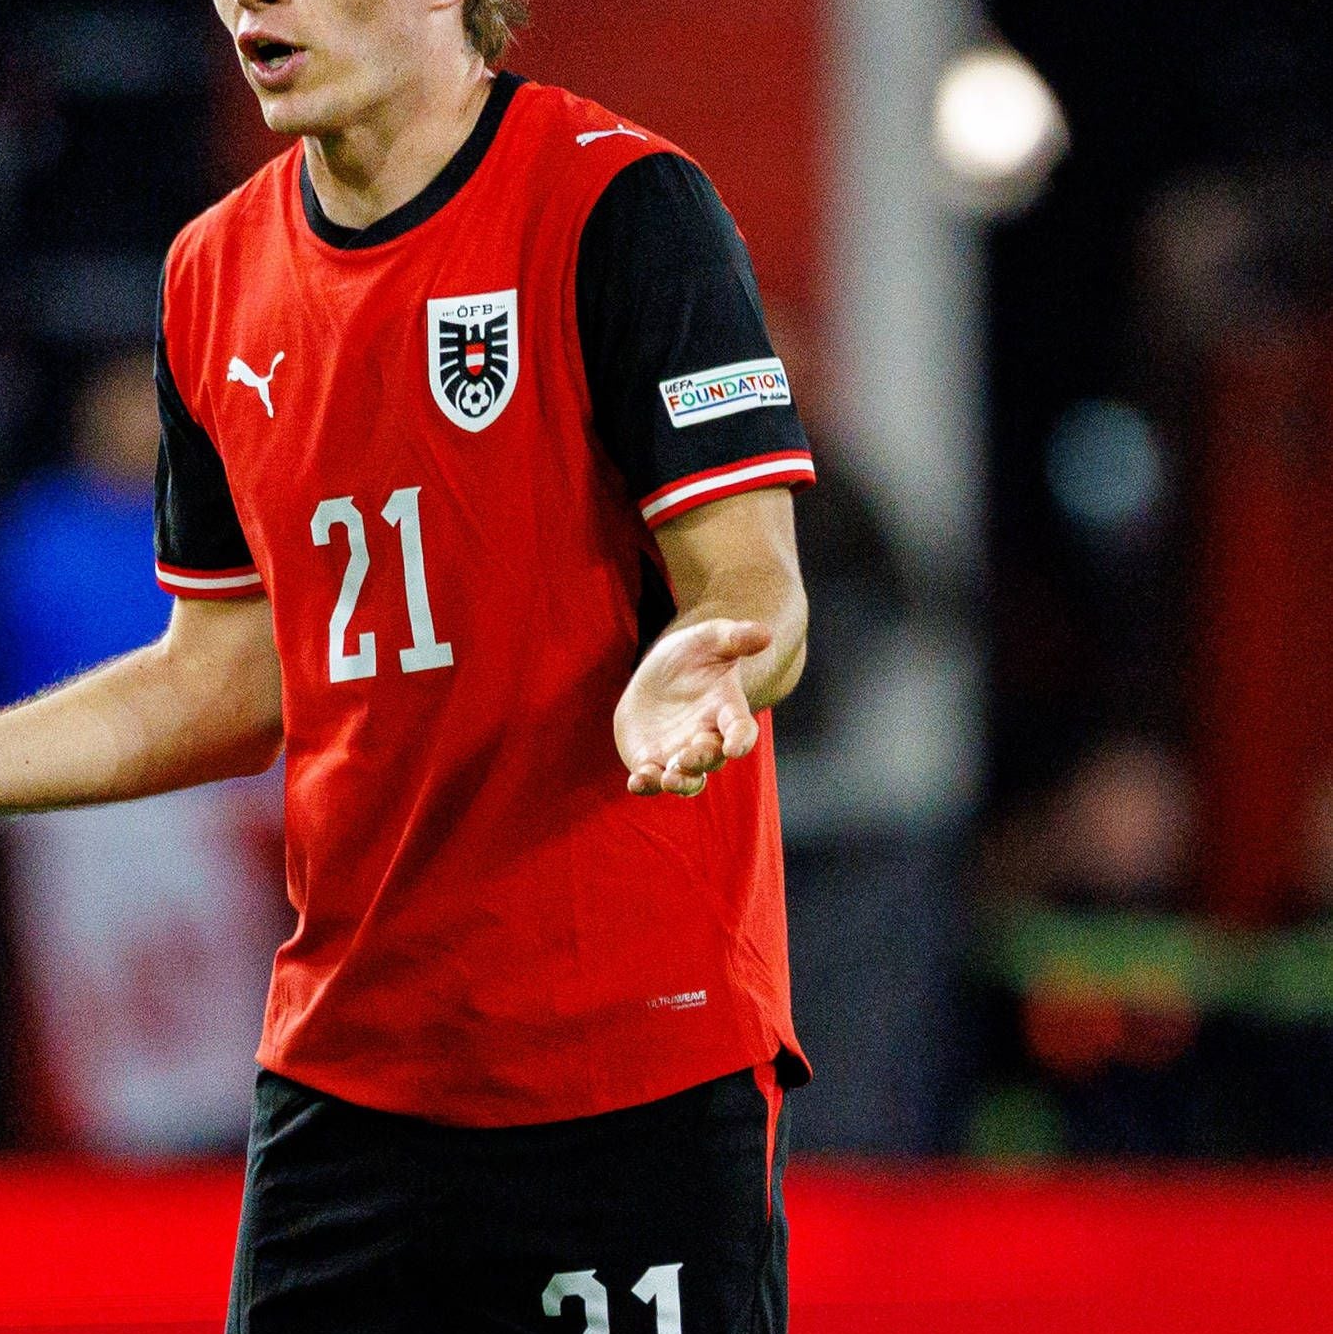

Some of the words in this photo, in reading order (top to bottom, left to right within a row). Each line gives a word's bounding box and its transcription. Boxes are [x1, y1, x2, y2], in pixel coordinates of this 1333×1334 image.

[457, 303, 493, 318] ÖFB
[665, 379, 694, 394] UEFA
[668, 373, 787, 412] FOUNDATION
[310, 485, 455, 684] 21
